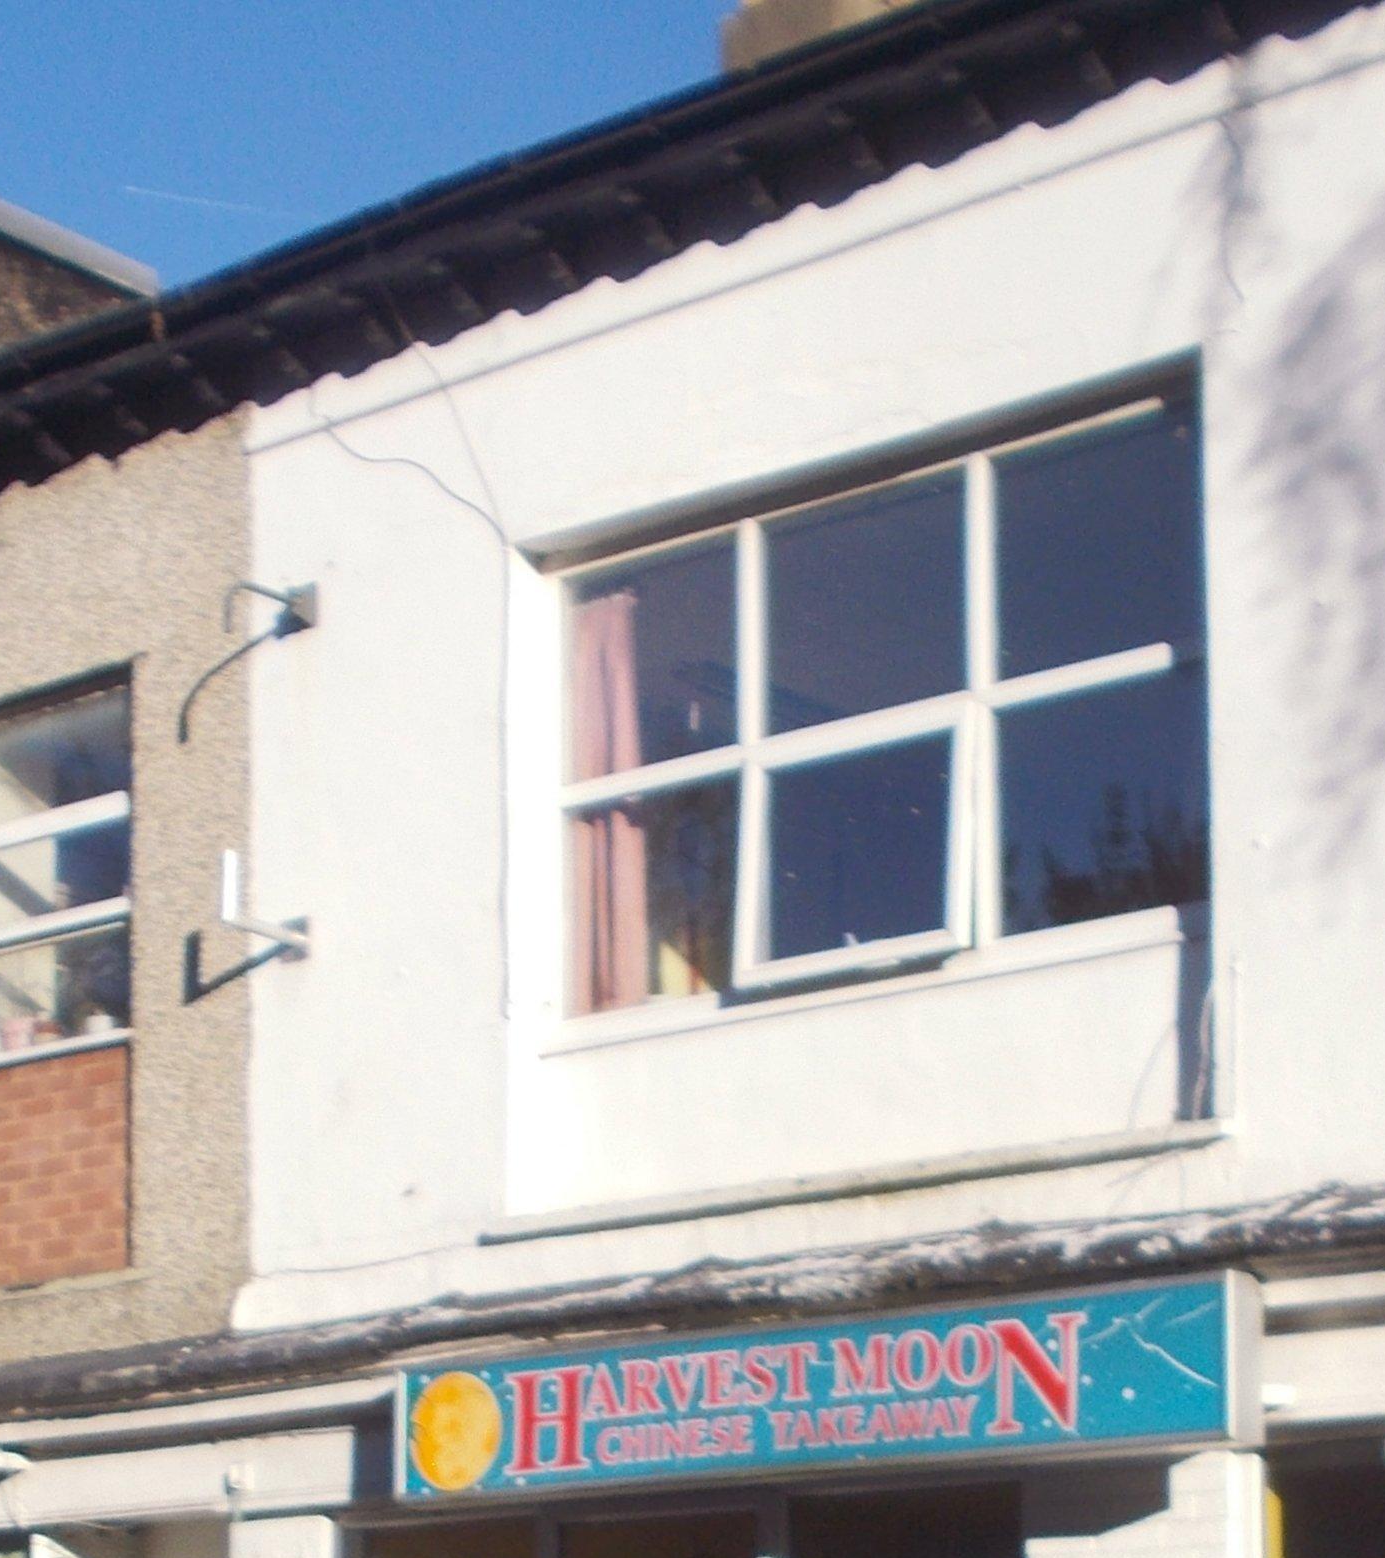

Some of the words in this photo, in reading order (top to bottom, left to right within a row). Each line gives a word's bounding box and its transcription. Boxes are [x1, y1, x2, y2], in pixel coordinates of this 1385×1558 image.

[504, 1341, 816, 1475] HARVEST
[832, 1311, 1088, 1437] MOON
[596, 1410, 753, 1467] CHINESE
[772, 1394, 980, 1452] TAKEAWAY
